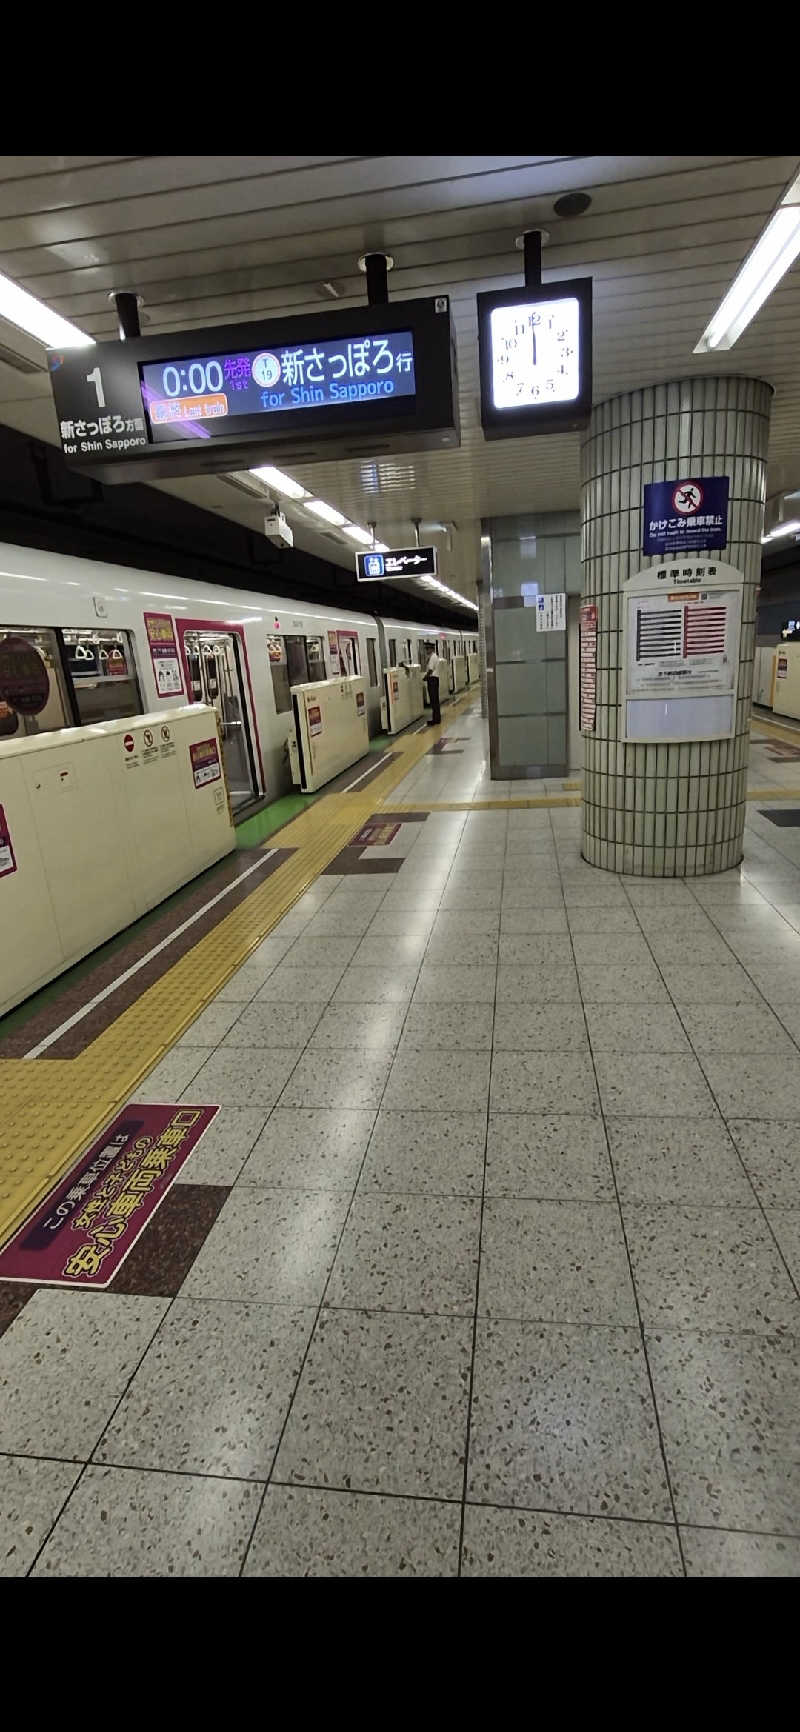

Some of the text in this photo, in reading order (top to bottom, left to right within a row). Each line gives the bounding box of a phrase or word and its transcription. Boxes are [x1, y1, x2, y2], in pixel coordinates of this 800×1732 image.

[163, 361, 224, 397] 0:00
[224, 357, 252, 380] 先発
[261, 369, 273, 381] 19
[281, 339, 413, 386] 新さっぽろ行
[86, 367, 106, 408] 1
[260, 380, 394, 409] for Shin Sapporo
[60, 415, 144, 439] 新さっぽろ方面
[63, 437, 146, 454] for Shin Sapporo
[44, 1133, 130, 1230] この乗車位置は
[62, 1109, 203, 1278] 安心車両乗車口
[72, 1136, 153, 1230] 女性と子どもの
